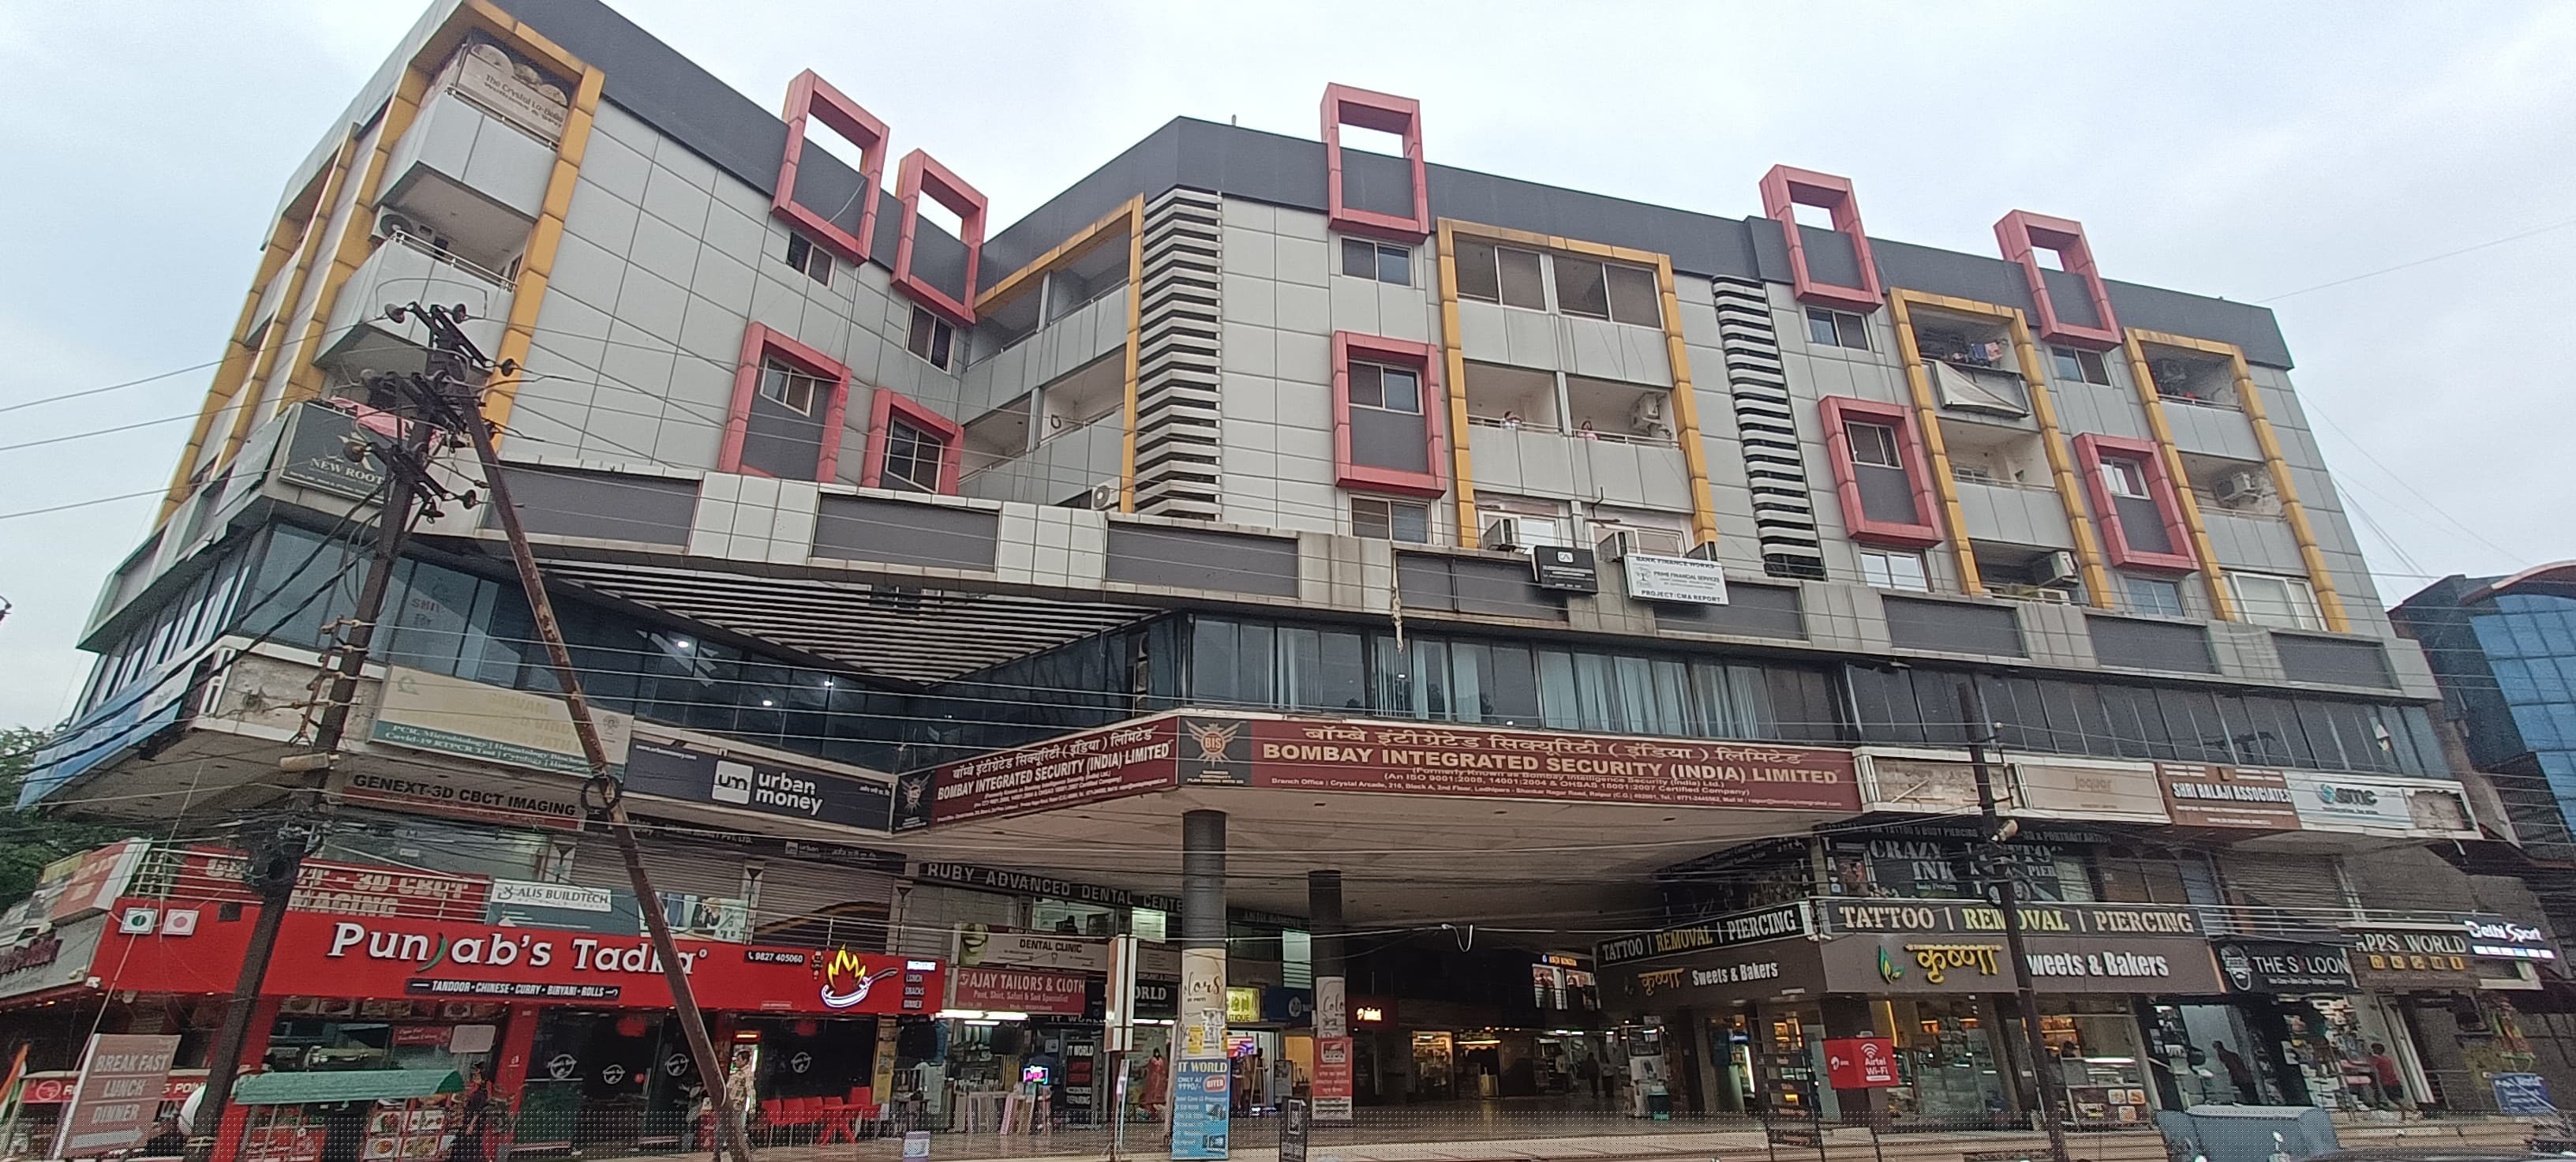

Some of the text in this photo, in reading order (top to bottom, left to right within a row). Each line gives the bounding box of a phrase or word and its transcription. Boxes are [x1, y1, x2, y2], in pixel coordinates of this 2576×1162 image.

[486, 74, 501, 88] The
[502, 83, 531, 106] Crystal
[310, 458, 343, 473] NEW
[1657, 559, 1689, 568] FINANCE
[384, 731, 432, 746] Covid-19
[1204, 737, 1222, 749] BIS
[937, 781, 975, 800] BOMBAY
[975, 770, 1033, 793] INTEGRATED
[1034, 758, 1085, 782] SECURITY
[1086, 751, 1122, 775] (INDIA)
[1124, 742, 1170, 765] LIMITED
[1263, 743, 1839, 785] BOMBAY INTEGRATED SECURITY (INDIA) LIMITED
[758, 771, 816, 795] urban
[1522, 772, 1564, 782] Bombay
[1567, 774, 1626, 783] Intelligence
[1627, 777, 1668, 786] Security
[354, 774, 577, 816] GENEXT-3D CBCT IMAGING
[1702, 787, 1750, 796] Company)
[2171, 782, 2292, 803] SHRI BALAJI ASSOCIATES
[755, 789, 823, 816] money
[1870, 839, 1941, 860] CRAZY
[1911, 860, 1957, 883] INK
[518, 885, 542, 899] ALIS
[545, 889, 608, 905] BUILDTECH
[927, 863, 1182, 913] RUBY ADVANCED DENTAL CENTE
[289, 889, 399, 918] MAGING
[1838, 905, 1936, 930] TATTOO
[2091, 910, 2196, 934] PIERCING
[2463, 920, 2508, 939] Delhi
[1602, 909, 1797, 961] TATTOO REMOVAL PIERCING
[2404, 934, 2467, 953] WORLD
[1019, 939, 1083, 954] DENTAL CLINIC
[755, 952, 804, 963] 9827 405060
[2026, 951, 2086, 978] weets
[2087, 953, 2103, 977] &
[2105, 951, 2170, 978] Bakers
[2252, 957, 2287, 973] THE
[970, 972, 1086, 995] AJAY TAILORS & CLOTH
[1691, 966, 1728, 986] Sweets
[1730, 967, 1739, 981] &
[1739, 961, 1779, 983] Bakers
[432, 980, 605, 998] TANDOOR CHINESE CURRY BIRYANI ROLLS
[1135, 985, 1167, 1001] ORLD
[1227, 1014, 1250, 1022] UTIQUE
[94, 1054, 169, 1073] BREAK FAST
[1178, 1061, 1228, 1073] IT WORLD
[1865, 1056, 1886, 1066] Airtel
[1866, 1066, 1889, 1075] Wi-Fi
[103, 1078, 145, 1098] LUNCH
[92, 1104, 140, 1124] DINNER
